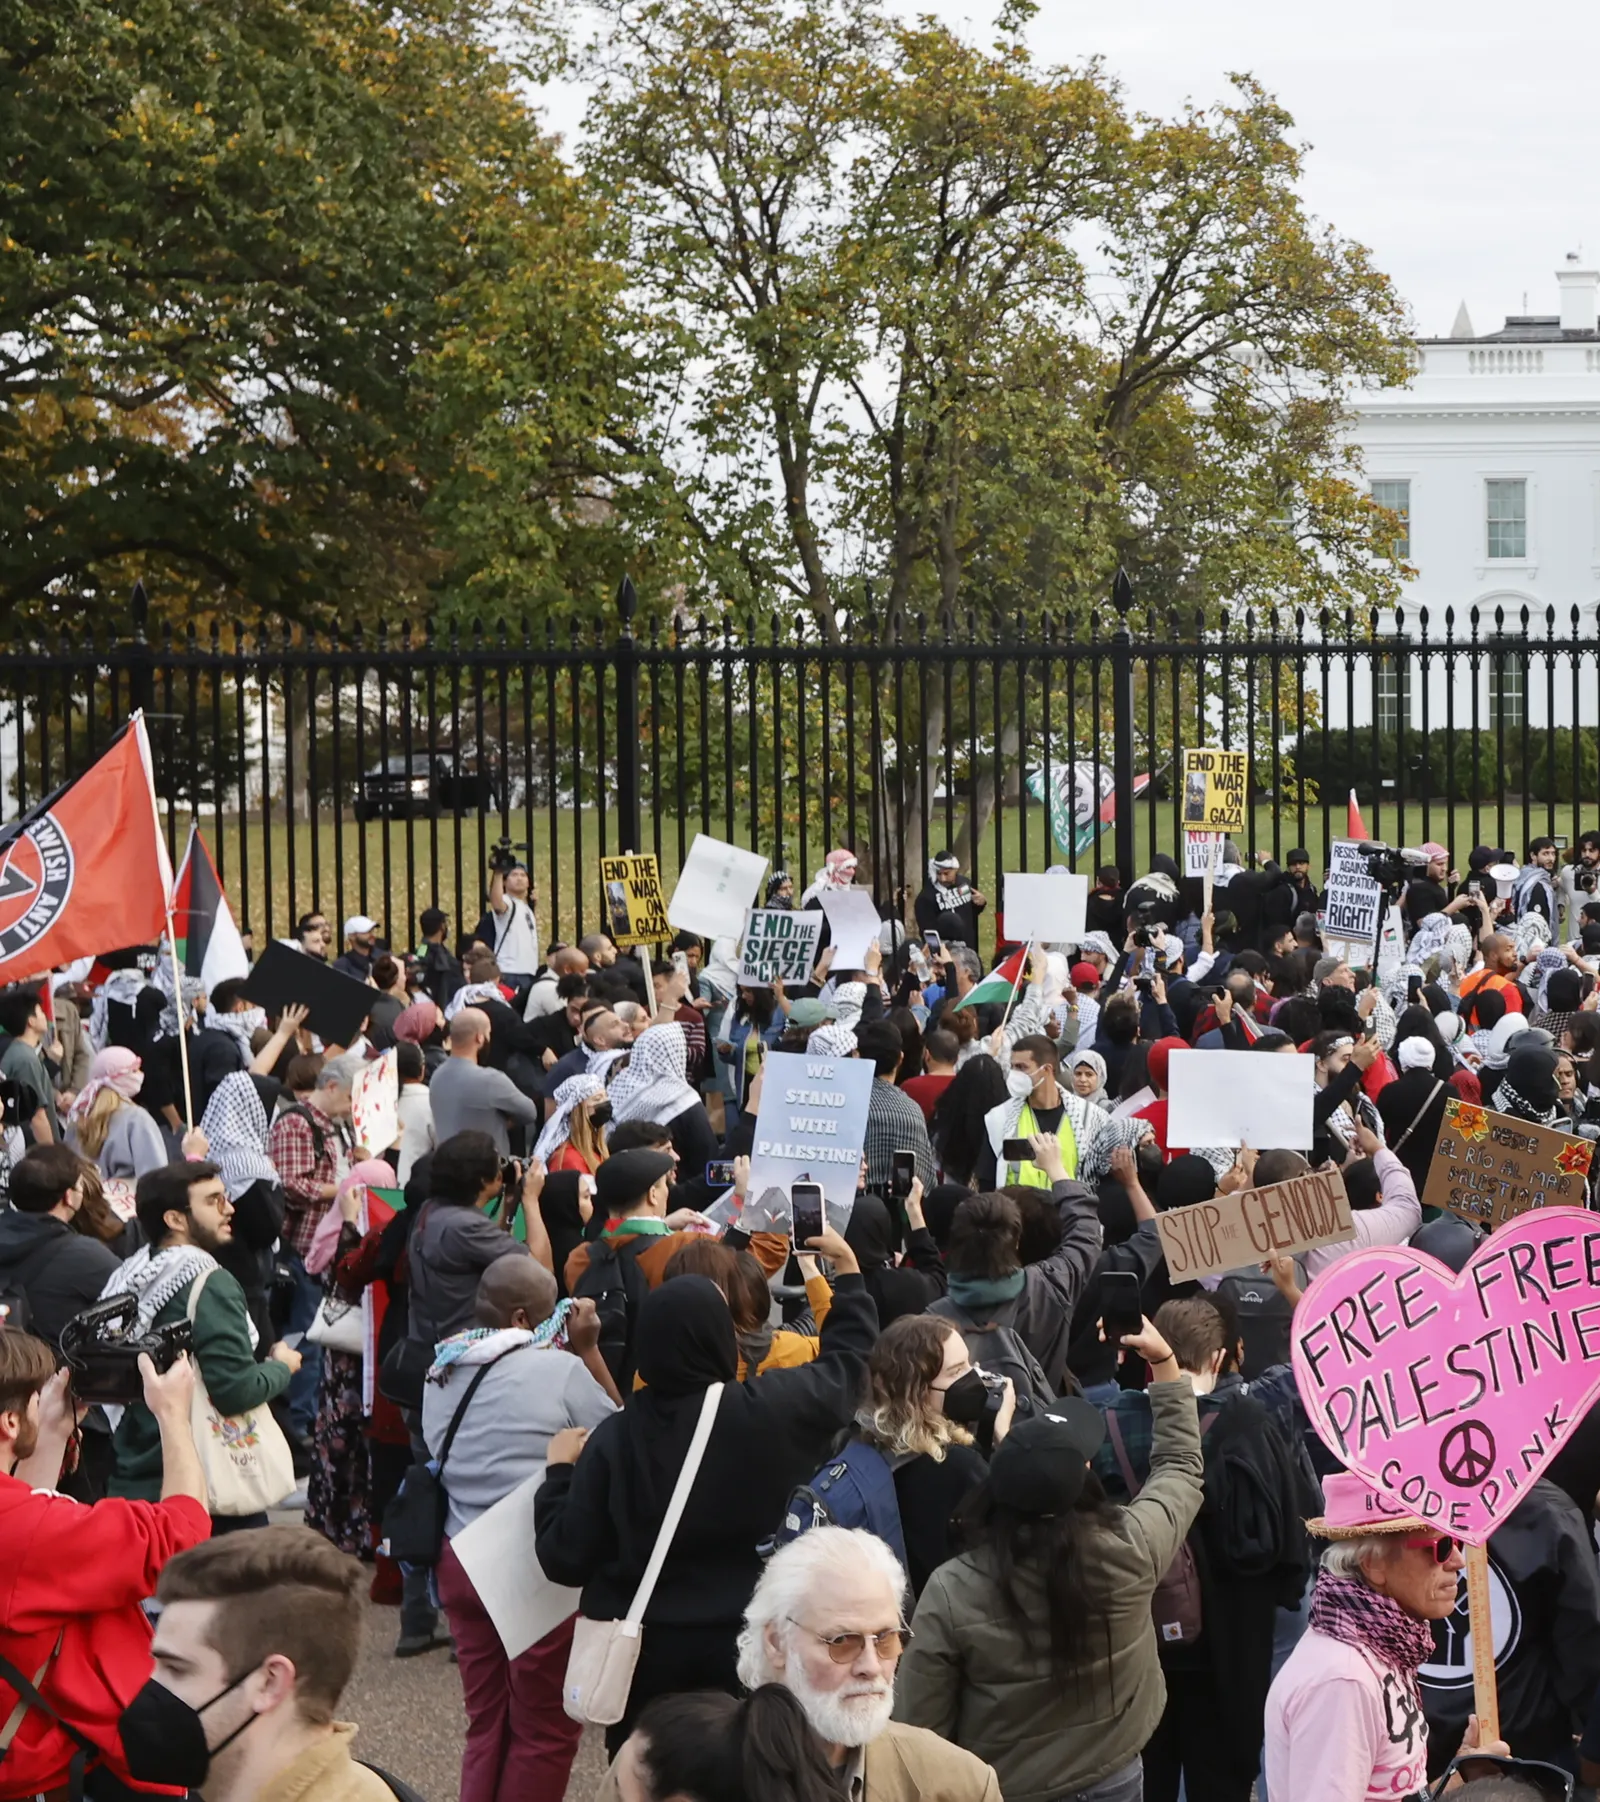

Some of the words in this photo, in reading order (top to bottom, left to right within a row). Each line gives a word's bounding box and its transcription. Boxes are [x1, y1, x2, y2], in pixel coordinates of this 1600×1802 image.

[1187, 753, 1215, 771] END
[1219, 754, 1245, 773] THE
[1213, 772, 1243, 791] WAR
[1225, 792, 1243, 808] ON
[1210, 807, 1242, 825] GAZA
[28, 817, 68, 882] EWISH
[1187, 844, 1200, 855] LET
[1202, 844, 1222, 854] GZA
[604, 861, 629, 881] END
[630, 858, 656, 878] THE
[1340, 860, 1369, 876] AGAINS
[629, 879, 660, 899] WAR
[1331, 873, 1378, 891] OCCUPATION
[646, 899, 665, 916] ON
[1331, 890, 1338, 902] IS
[1340, 891, 1345, 904] A
[1346, 893, 1377, 909] HUMAN
[13, 891, 60, 942] ANTI
[636, 916, 670, 937] GAZA
[749, 913, 793, 938] END
[793, 925, 816, 939] THE
[1328, 904, 1374, 931] RIGHT!
[744, 939, 814, 963] SIEGE
[744, 965, 758, 977] ON
[805, 1062, 835, 1080] WE
[785, 1088, 846, 1108] STAND
[789, 1116, 838, 1135] WITH
[1491, 1126, 1539, 1155] DESDE
[757, 1141, 857, 1165] PALESTINE
[1439, 1138, 1458, 1159] EL
[1465, 1146, 1494, 1169] RÍO
[1501, 1160, 1523, 1180] AL
[1529, 1170, 1571, 1196] MAR
[1448, 1166, 1545, 1208] PALESTINA
[1162, 1205, 1222, 1272] STOP
[1221, 1223, 1240, 1241] THE
[1240, 1171, 1351, 1253] GENOCIDE
[1299, 1267, 1439, 1388] FREE
